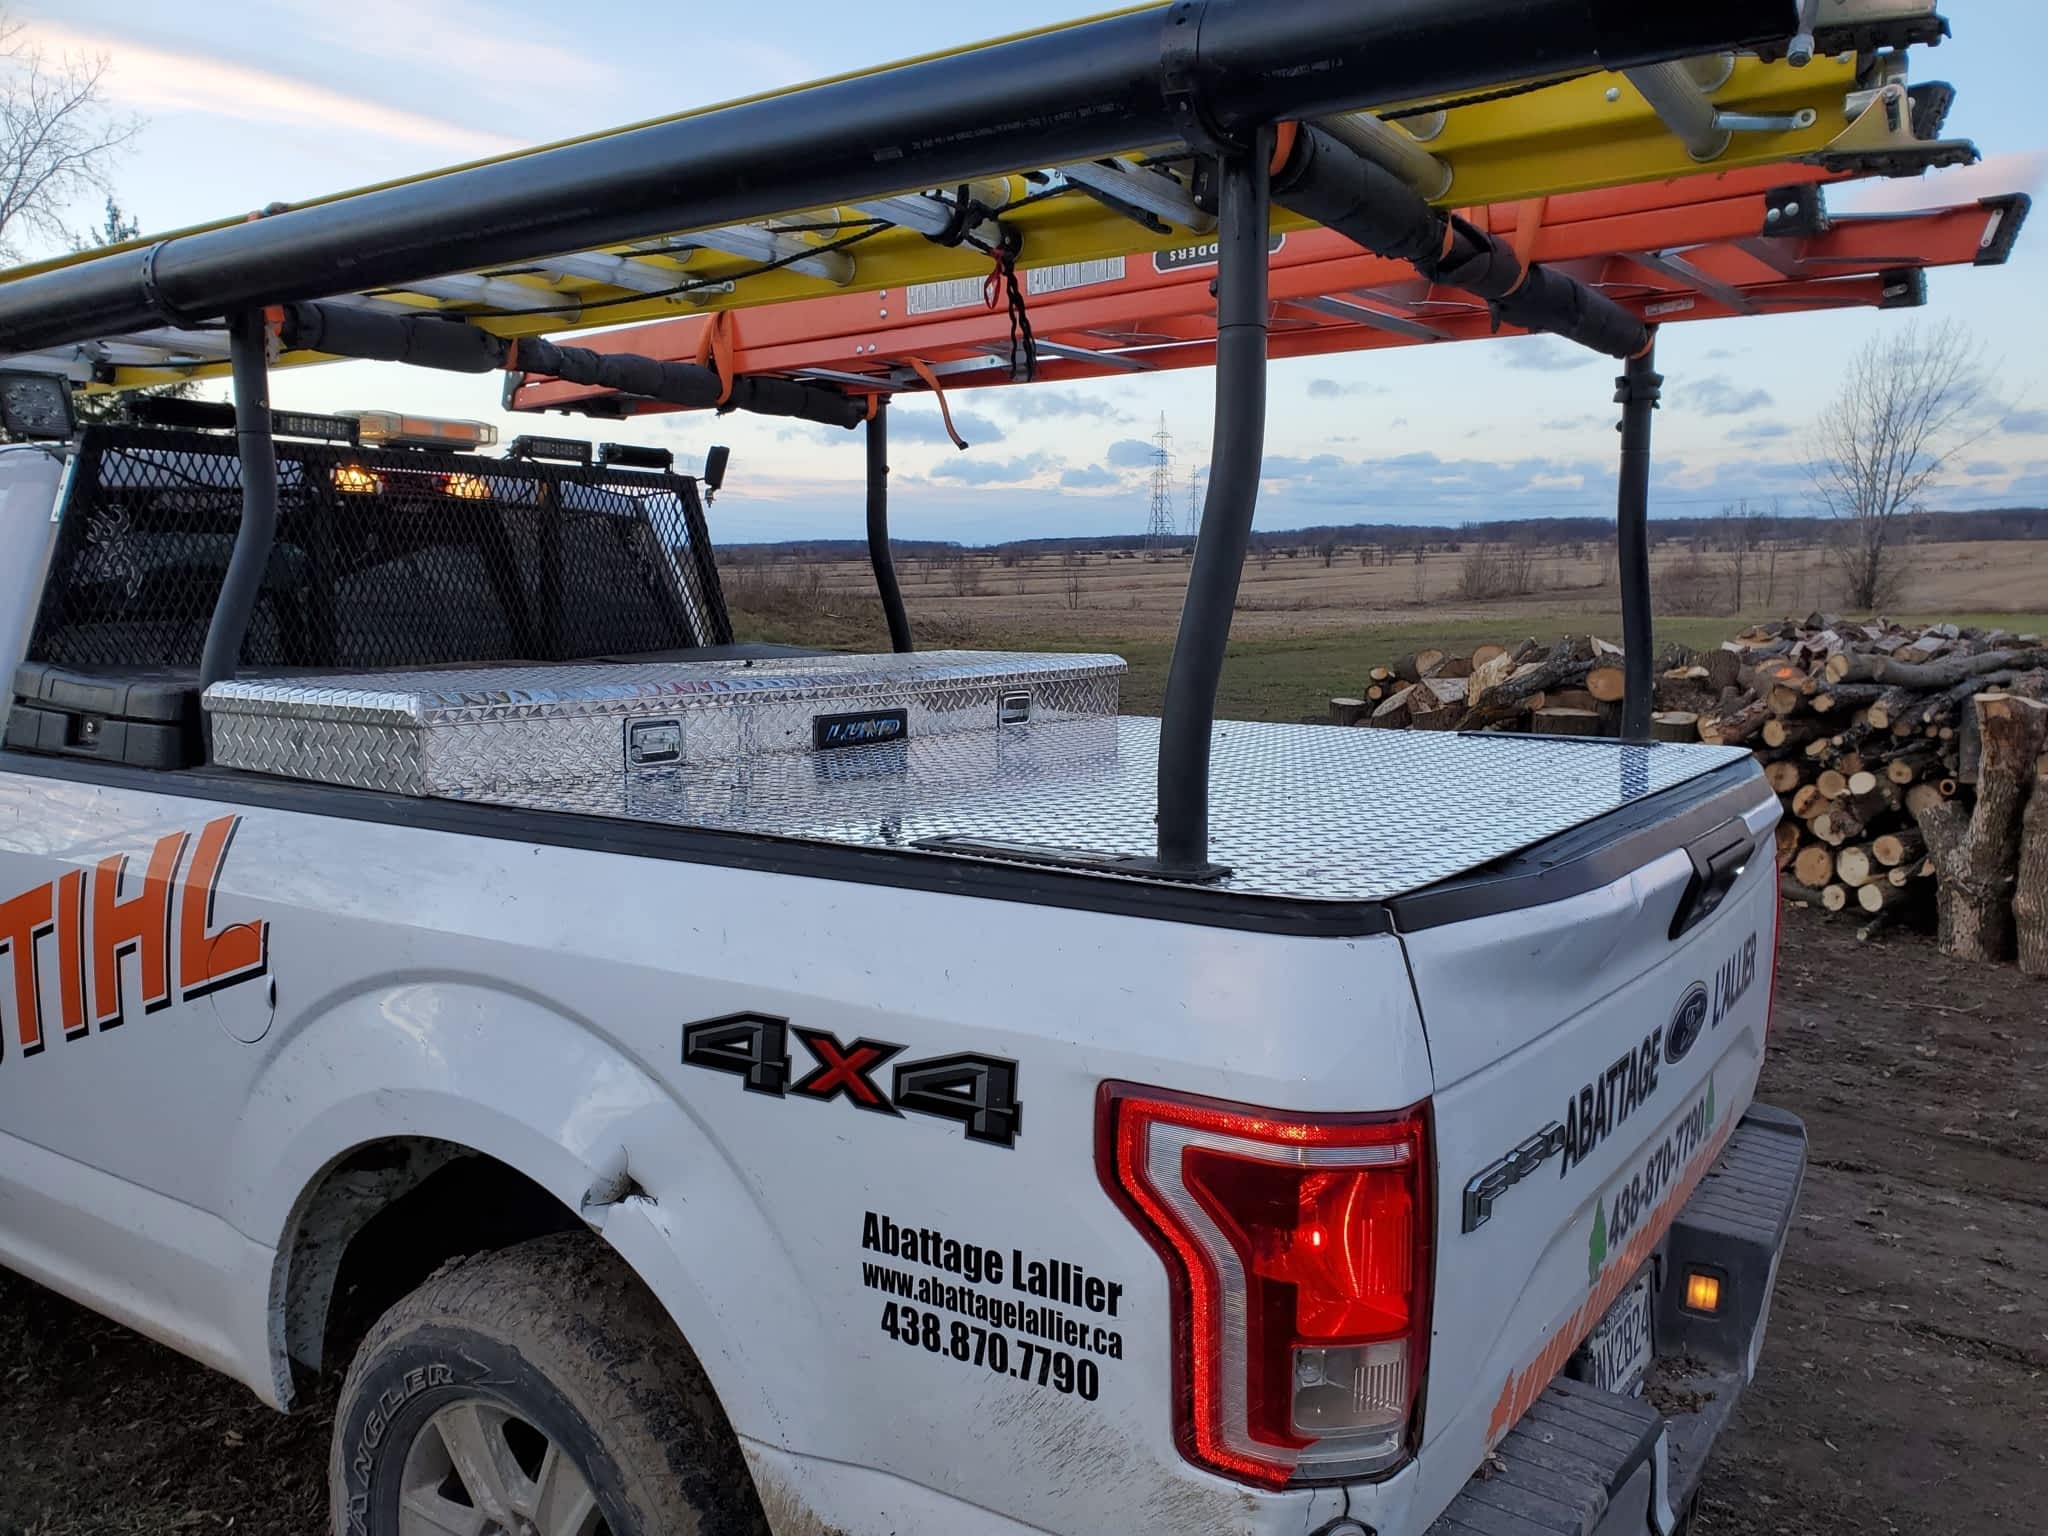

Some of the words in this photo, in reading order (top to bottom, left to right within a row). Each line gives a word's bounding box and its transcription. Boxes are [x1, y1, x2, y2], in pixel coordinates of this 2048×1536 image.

[1169, 242, 1219, 262] DDERS
[0, 813, 270, 1060] TIHL
[1560, 1024, 1662, 1180] ABATTAGE
[1607, 1096, 1705, 1250] 438-870-7790
[862, 1211, 1003, 1285] Abattage
[1012, 1249, 1123, 1317] Lallier
[862, 1262, 1123, 1360] www.abattagelallier.ca
[881, 1301, 1099, 1402] 438.870.7790
[1594, 1292, 1650, 1392] NX2824
[350, 1363, 454, 1536] ANGLER
